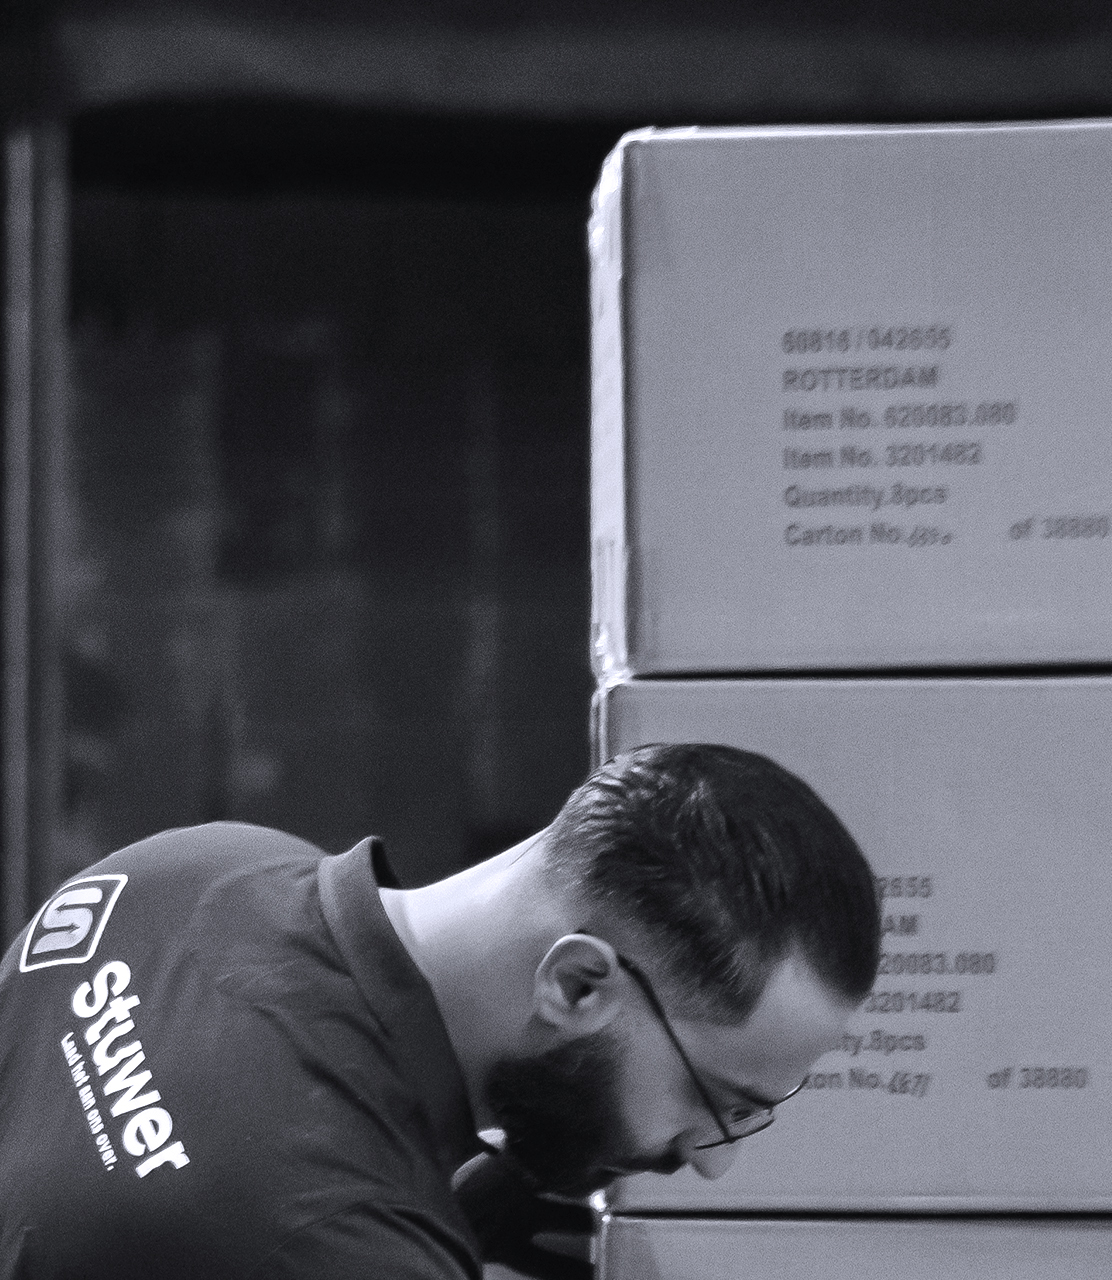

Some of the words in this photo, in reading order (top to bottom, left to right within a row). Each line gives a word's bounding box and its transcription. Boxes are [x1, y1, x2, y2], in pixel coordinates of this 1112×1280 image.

[782, 364, 940, 391] ROTTERDAM
[783, 408, 833, 430] Item
[840, 405, 877, 429] No.
[783, 447, 833, 469] Item
[840, 444, 878, 468] No.
[885, 441, 983, 467] 3201482
[784, 522, 863, 547] Carton
[1008, 516, 1035, 541] of
[877, 952, 995, 975] 20083.080
[72, 960, 191, 1178] Stuwer
[987, 1067, 1013, 1091] of
[87, 1108, 105, 1135] ons
[95, 1133, 118, 1171] over.
